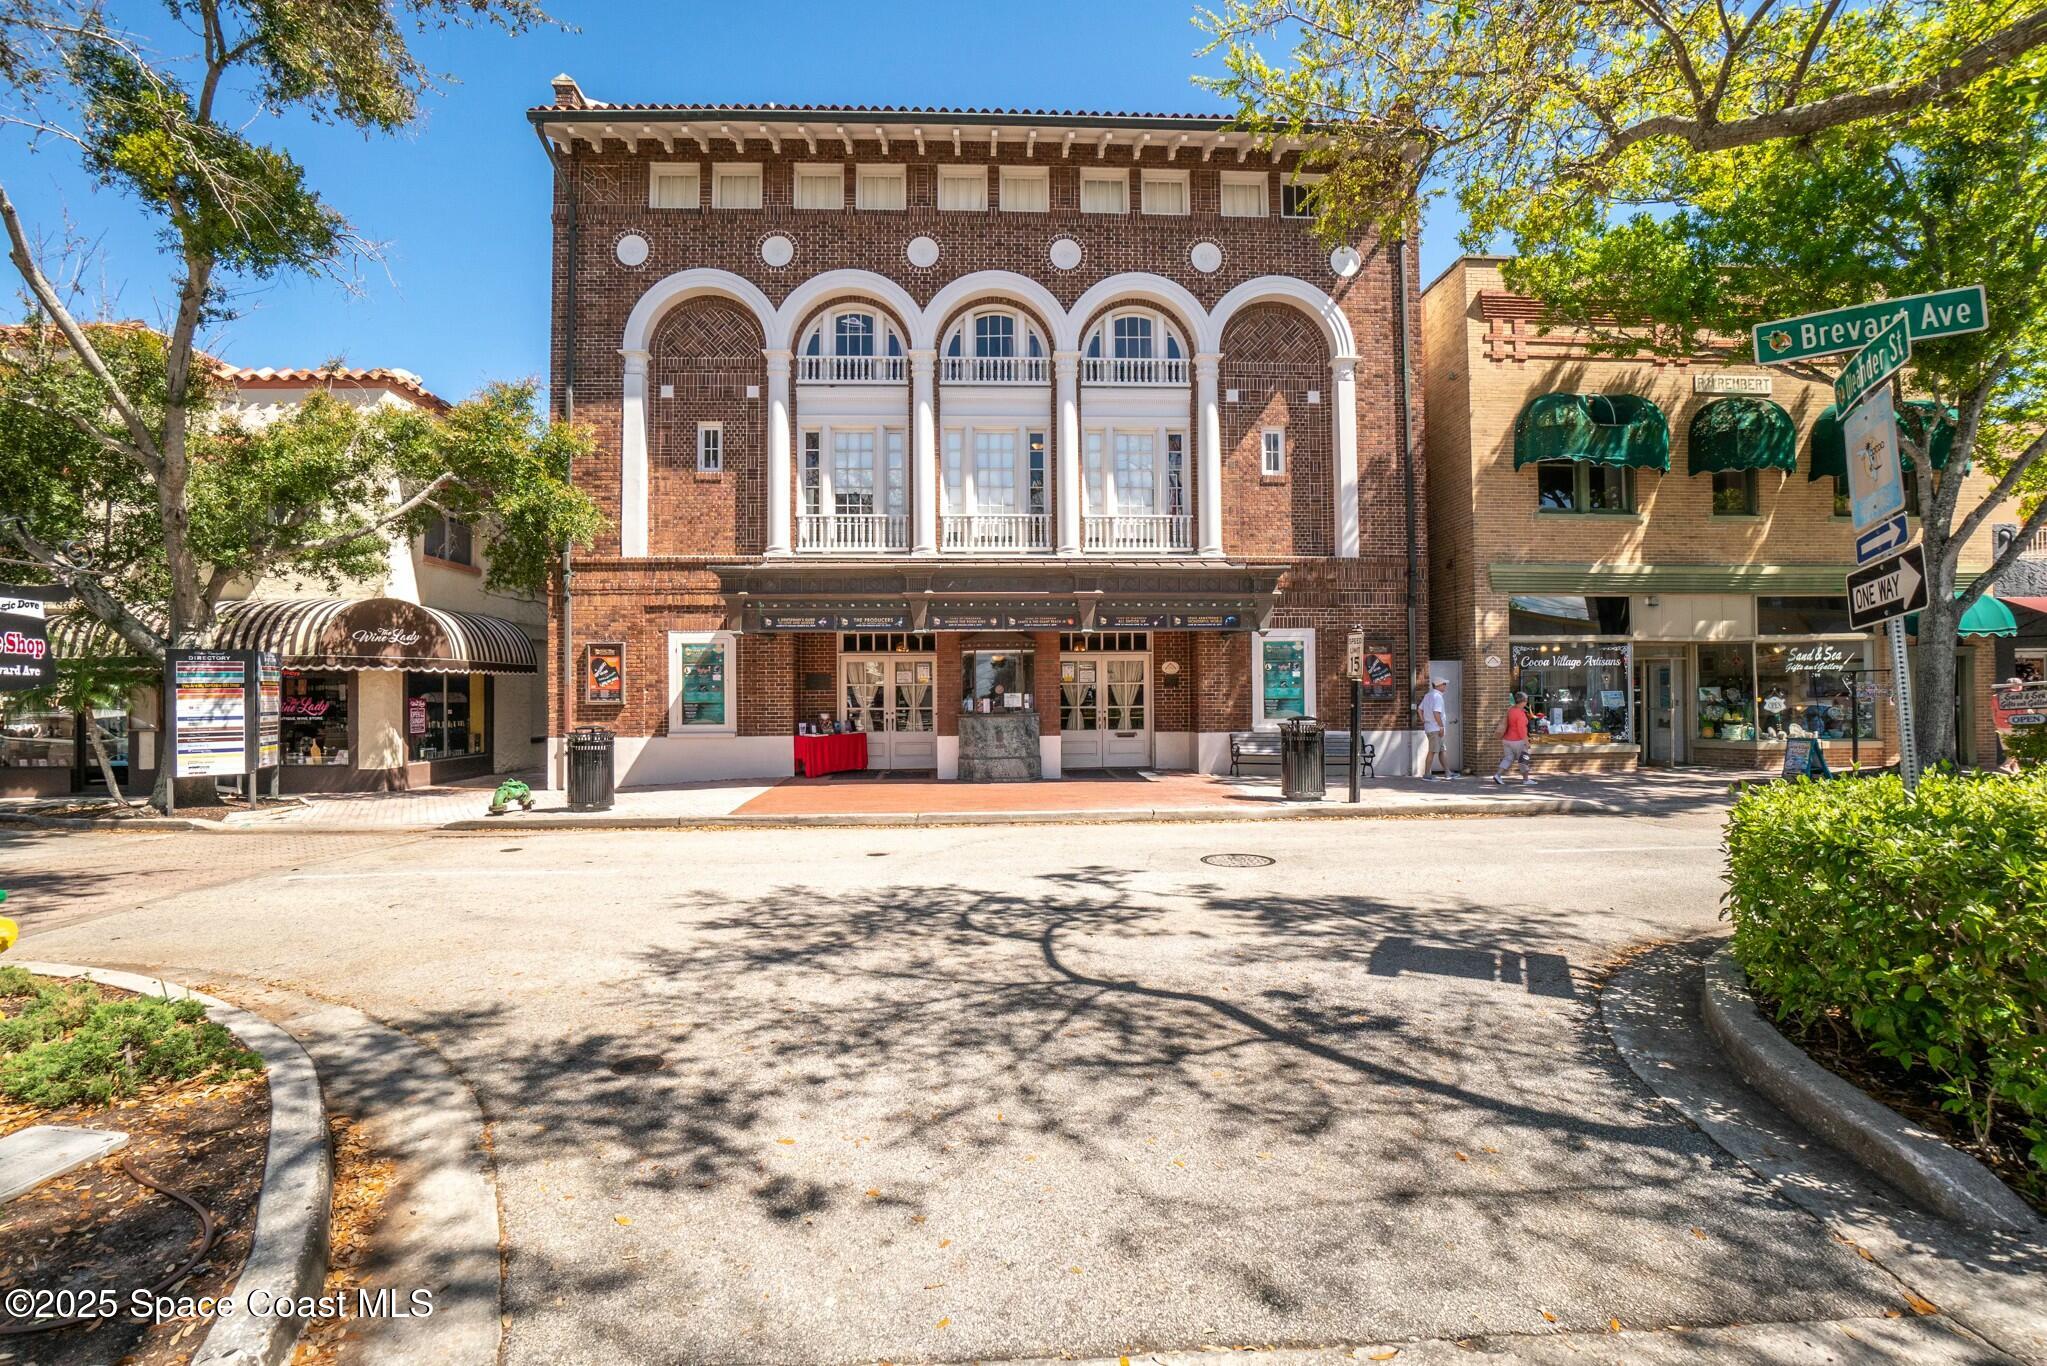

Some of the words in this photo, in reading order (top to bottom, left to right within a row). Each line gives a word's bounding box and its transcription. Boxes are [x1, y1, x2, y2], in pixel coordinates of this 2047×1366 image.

[1920, 302, 1972, 330] Ave
[1845, 348, 1886, 400] Oleander
[1888, 329, 1904, 362] St
[1717, 377, 1769, 391] REMBERT
[1855, 583, 1876, 610] ONE
[1877, 573, 1899, 602] WAY
[17, 600, 40, 609] Dove
[352, 629, 388, 642] Wine
[388, 628, 420, 646] Lady
[377, 627, 392, 636] The
[4, 632, 46, 659] Shop
[1787, 647, 1815, 661] Sand
[1814, 646, 1822, 661] &
[1823, 645, 1843, 661] Sea
[1350, 656, 1360, 672] 15
[1520, 655, 1550, 667] Cocoa
[1552, 655, 1582, 669] Village
[1583, 655, 1621, 666] Artisans
[1785, 663, 1803, 673] Gifts
[1816, 662, 1844, 672] Gallery
[22, 665, 41, 676] Ave
[281, 702, 297, 713] ine
[297, 696, 330, 716] Lady
